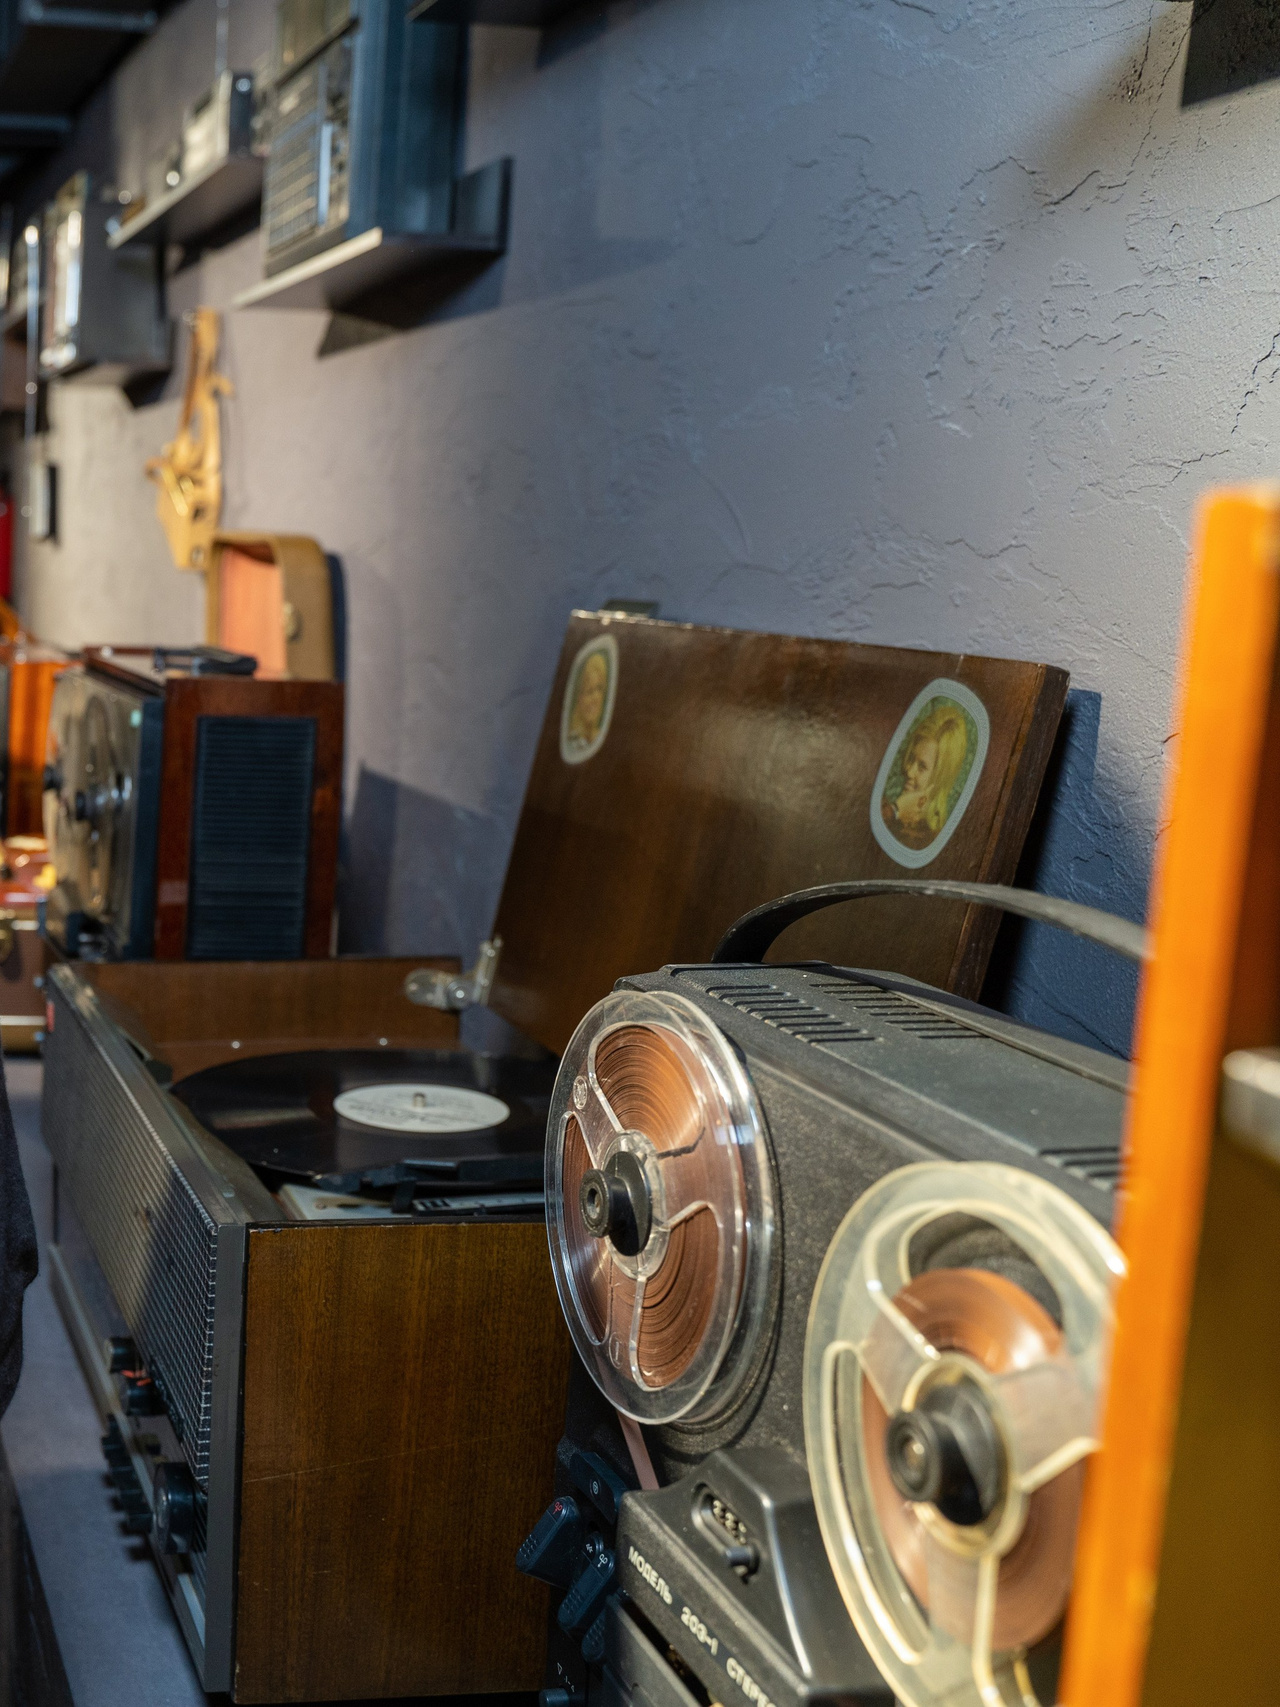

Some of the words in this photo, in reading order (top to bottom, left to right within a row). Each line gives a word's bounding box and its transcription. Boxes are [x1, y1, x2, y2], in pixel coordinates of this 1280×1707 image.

[628, 1546, 673, 1605] МОДЕЛЬ
[681, 1606, 719, 1656] 203-1
[726, 1657, 777, 1707] СТЕРЕ
